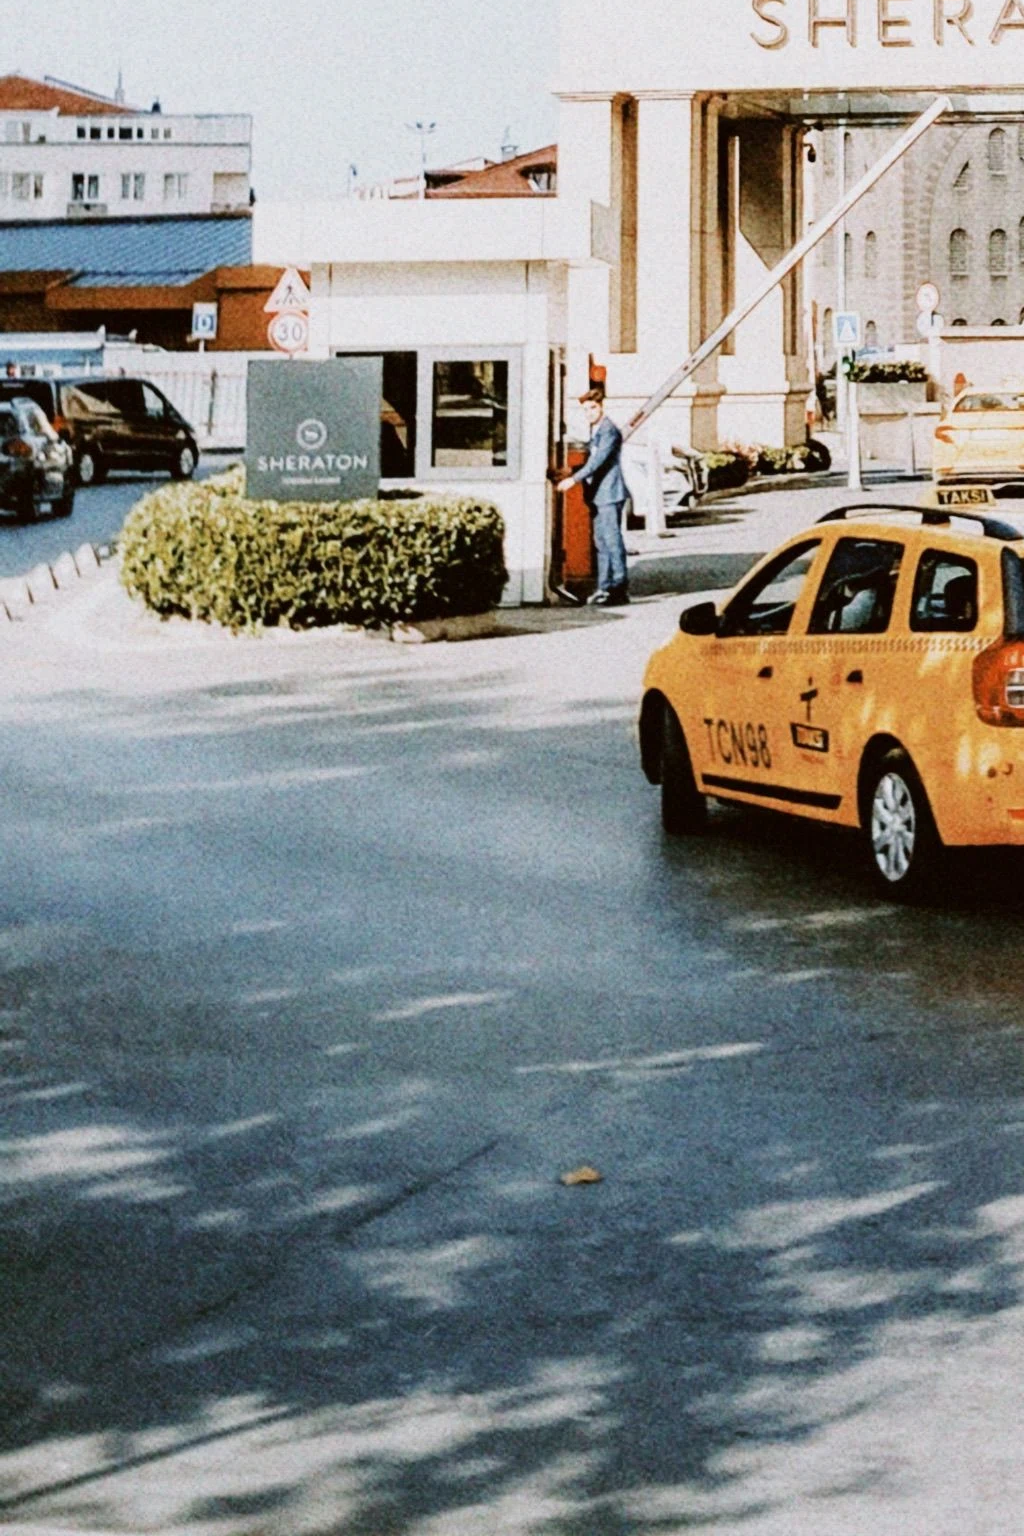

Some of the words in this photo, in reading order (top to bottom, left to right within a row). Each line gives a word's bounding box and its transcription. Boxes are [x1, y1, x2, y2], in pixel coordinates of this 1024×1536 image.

[278, 322, 303, 341] 30
[257, 453, 368, 471] SHERATON
[703, 718, 772, 769] TCN98
